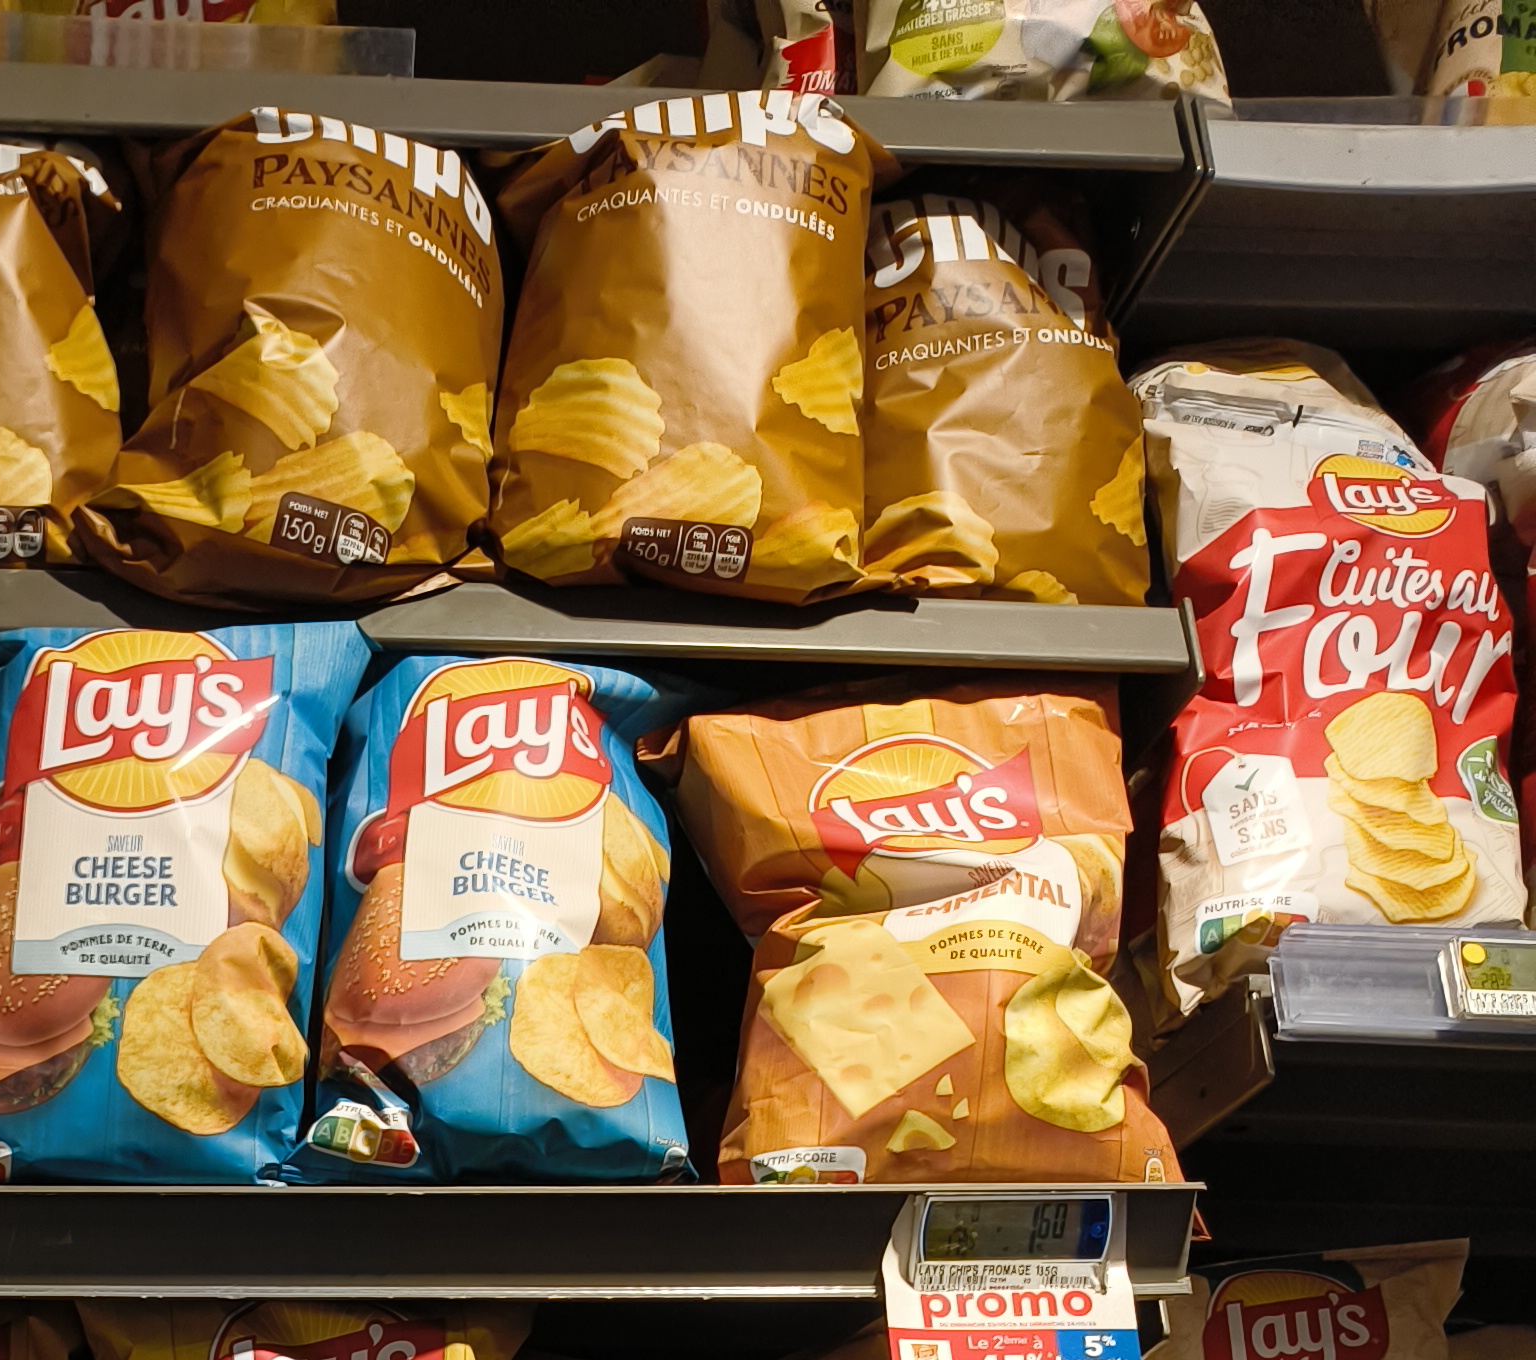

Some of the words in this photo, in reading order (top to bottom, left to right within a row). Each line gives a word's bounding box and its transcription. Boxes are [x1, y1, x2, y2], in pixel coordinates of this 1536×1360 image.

[931, 31, 963, 49] SANS
[579, 137, 850, 216] PAYSANNES
[251, 194, 379, 229] CRAQUANTES
[386, 219, 404, 238] ET
[252, 153, 491, 294] PAYSANNES
[577, 186, 704, 223] CRAQUANTES
[710, 193, 730, 208] ET
[735, 197, 836, 241] ONDULÉES
[1323, 471, 1444, 516] Lay's
[280, 512, 325, 553] 150g
[1317, 537, 1446, 609] Cuites
[1449, 567, 1501, 622] au
[1228, 527, 1515, 725] Four
[40, 655, 247, 771] Lay's
[424, 680, 600, 798] Lay's
[830, 772, 1011, 846] Lay's
[73, 856, 174, 880] CHEESE
[459, 850, 551, 889] CHEESE
[65, 882, 179, 909] BURGER
[451, 876, 559, 906] BURGER
[905, 873, 1072, 919] EMMENTAL
[1204, 895, 1293, 914] NUTRI-SCORE
[929, 930, 984, 955] POMMES
[988, 929, 1004, 940] DE
[1007, 930, 1046, 956] TERRE
[950, 949, 966, 960] DE
[970, 947, 1023, 961] QUALITÉ
[918, 1264, 944, 1276] LAYS
[949, 1265, 978, 1276] CHIPS
[982, 1265, 1031, 1276] FROMAGE
[920, 1290, 1093, 1328] promo
[968, 1336, 989, 1350] Le
[1033, 1334, 1043, 1349] à
[1084, 1335, 1116, 1356] 5%
